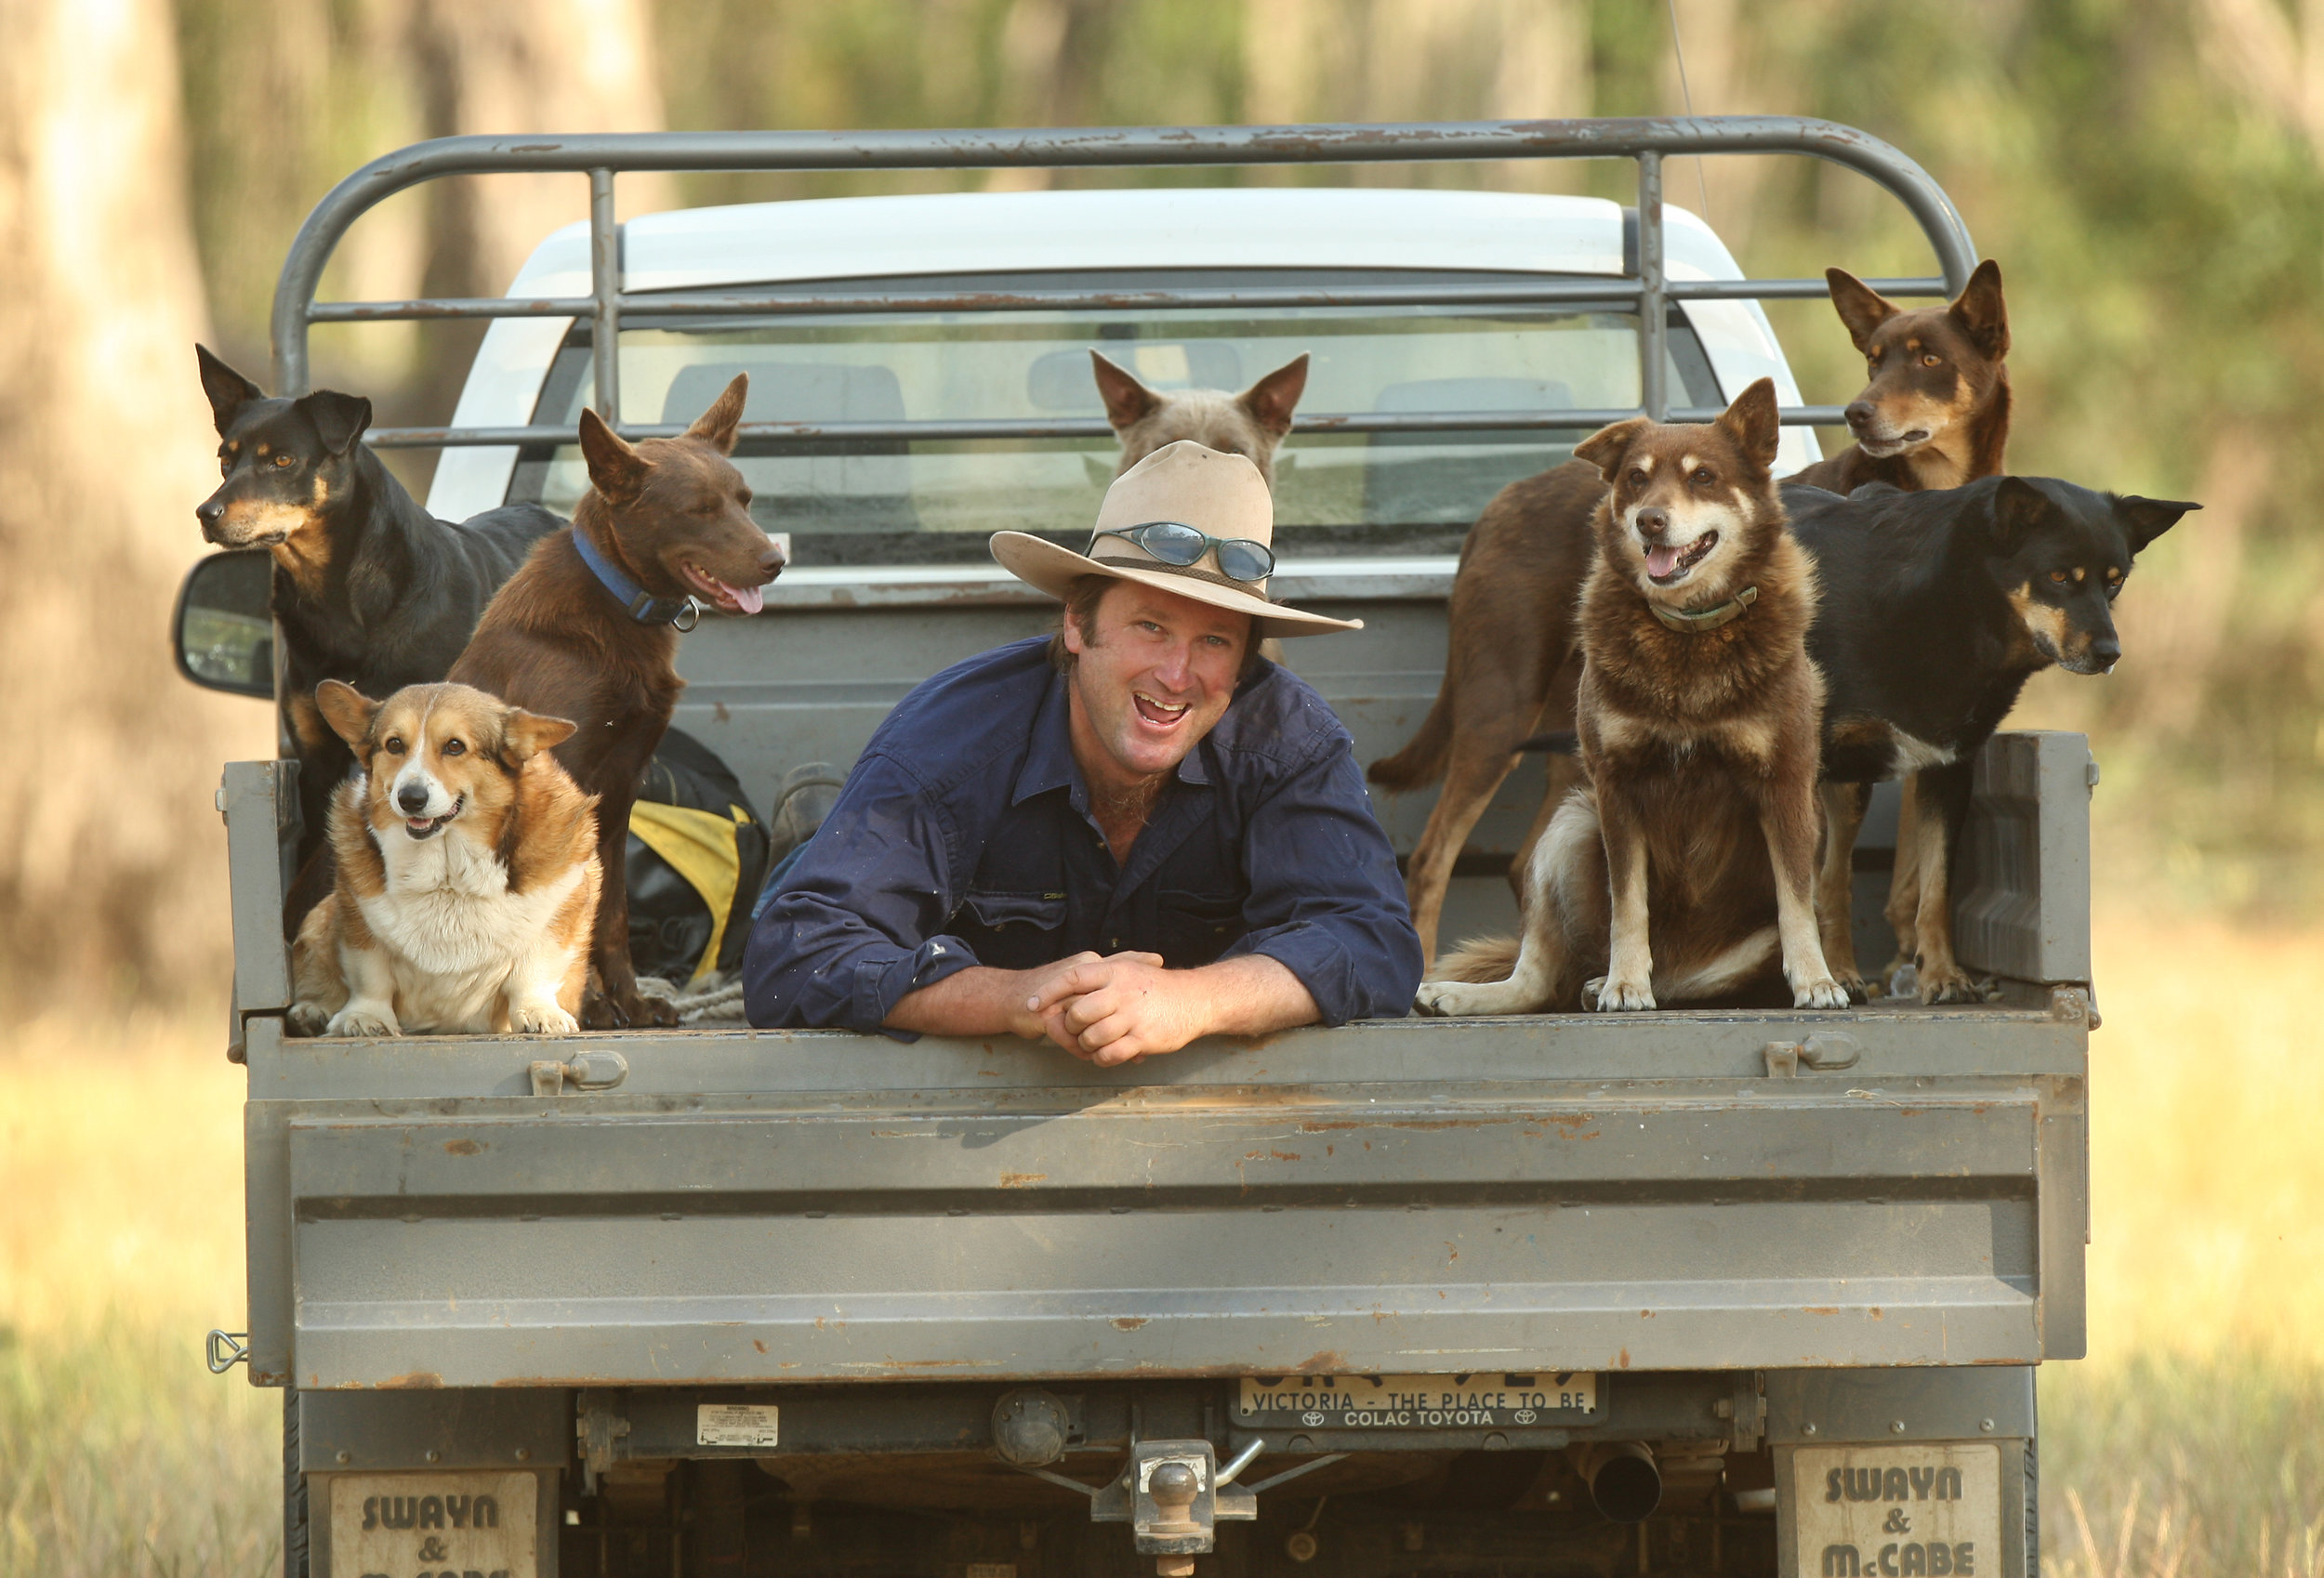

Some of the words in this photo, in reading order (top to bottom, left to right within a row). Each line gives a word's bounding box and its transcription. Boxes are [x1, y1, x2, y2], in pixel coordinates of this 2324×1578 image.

[1252, 1392, 1354, 1411] VICTORIA
[1388, 1392, 1428, 1410] THE
[1442, 1392, 1506, 1410] PLACE
[1518, 1392, 1546, 1409] TO
[1561, 1392, 1584, 1409] BE
[1344, 1411, 1410, 1426] COLAC
[1417, 1411, 1494, 1426] TOYOTA
[1827, 1466, 1962, 1502] SWAYN
[362, 1495, 498, 1531] SWAYN
[1883, 1507, 1910, 1532] &
[417, 1536, 448, 1562] &
